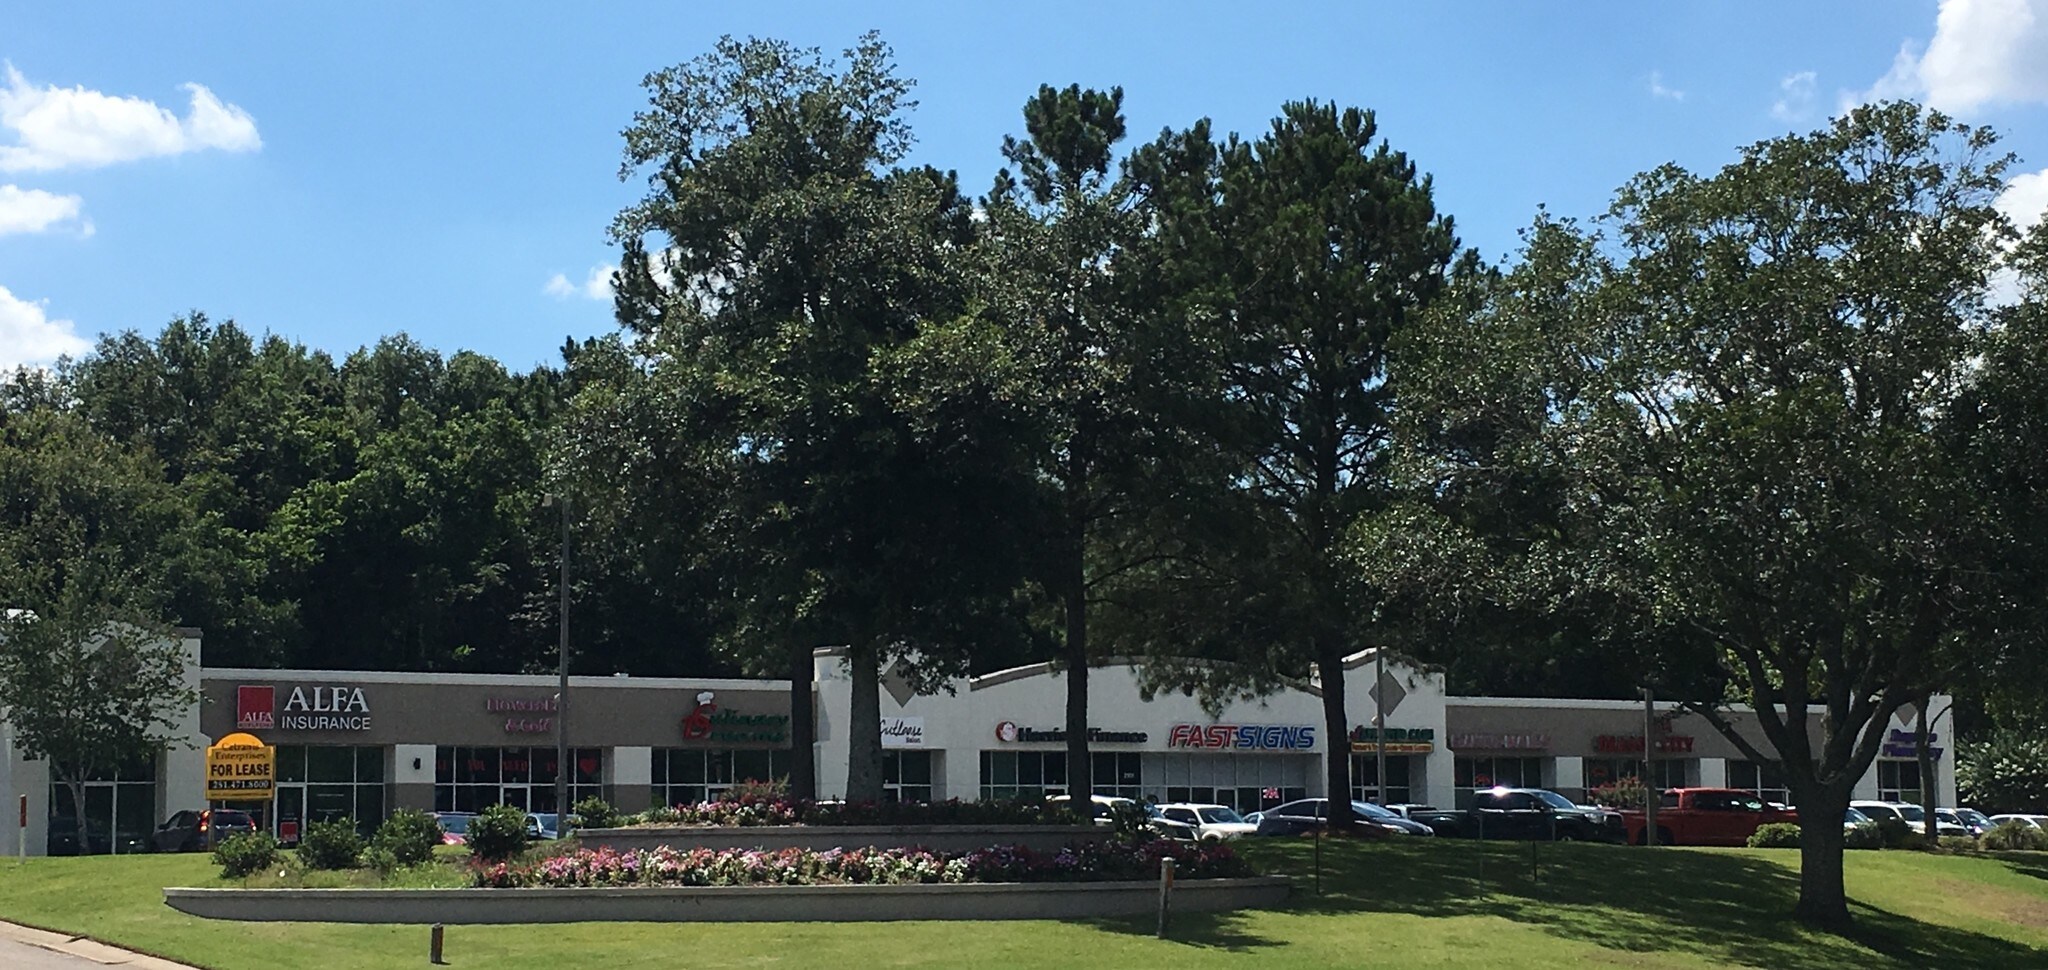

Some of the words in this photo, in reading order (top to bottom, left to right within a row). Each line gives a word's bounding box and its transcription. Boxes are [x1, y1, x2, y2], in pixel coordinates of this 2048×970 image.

[284, 686, 370, 713] ALFA
[243, 711, 274, 722] ALFA
[281, 716, 371, 730] INSURANCE
[1018, 727, 1068, 742] Harris
[1088, 727, 1149, 743] Finance
[1169, 724, 1317, 750] FASTSIGNS
[215, 752, 266, 762] Enterprises
[211, 764, 233, 777] FOR
[235, 763, 271, 776] LEASE
